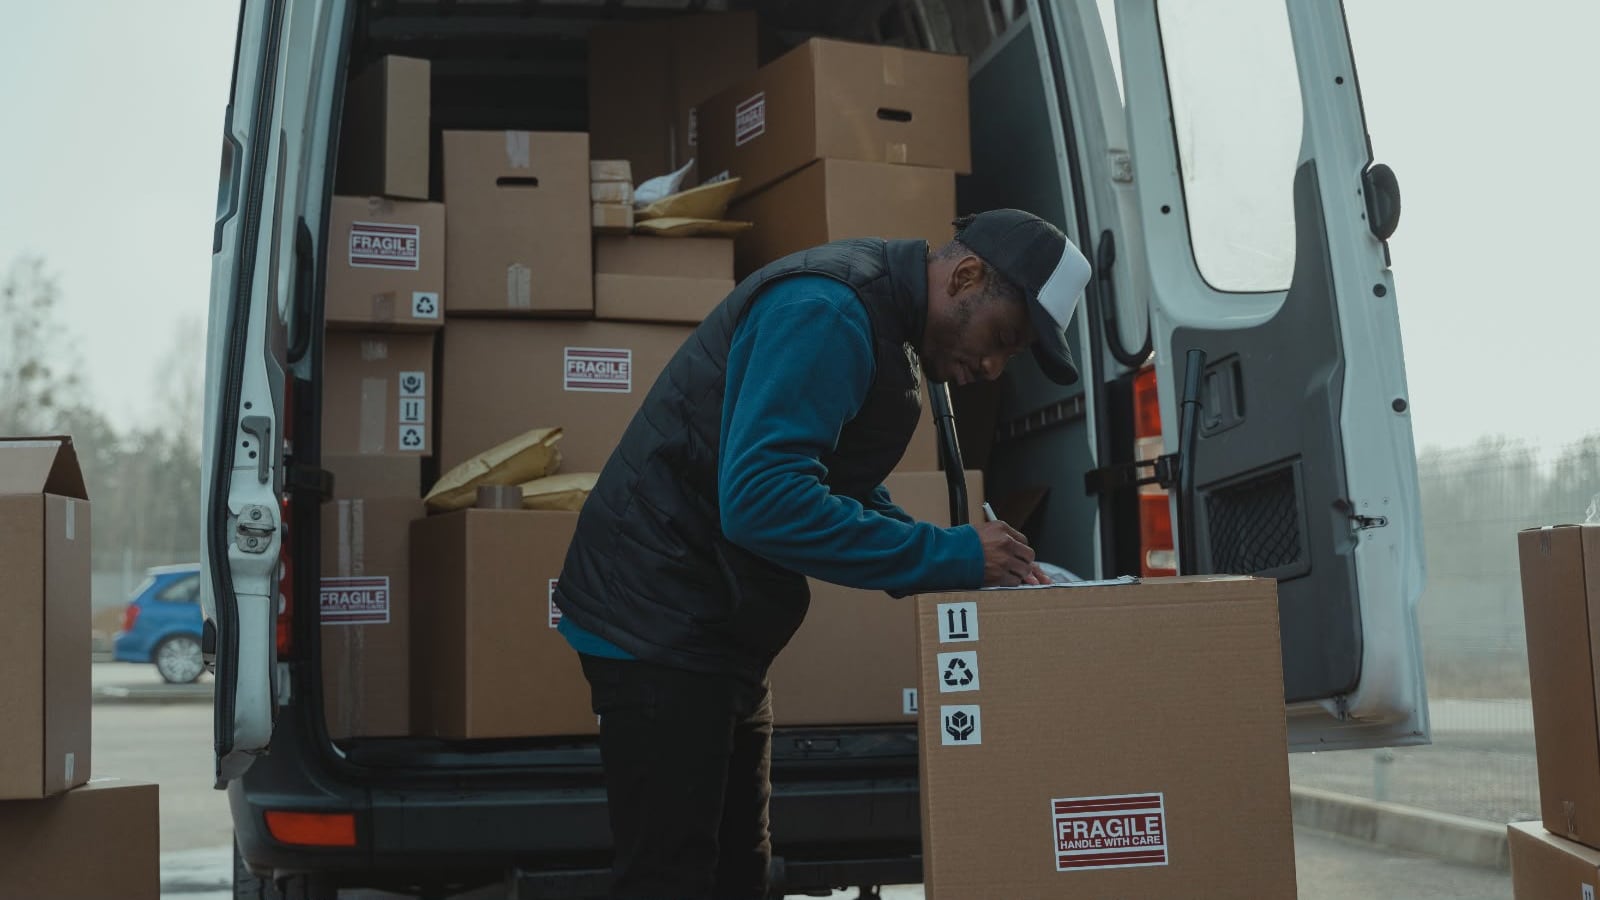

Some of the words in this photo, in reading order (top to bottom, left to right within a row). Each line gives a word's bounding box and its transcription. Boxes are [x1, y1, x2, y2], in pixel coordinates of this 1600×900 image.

[353, 236, 415, 251] FRAGILE
[568, 360, 628, 374] FRAGILE
[320, 591, 384, 605] FRAGILE
[1058, 816, 1160, 840] FRAGILE
[1060, 838, 1102, 850] HANDLE
[1104, 837, 1130, 847] WITH
[1132, 835, 1161, 845] CARE
